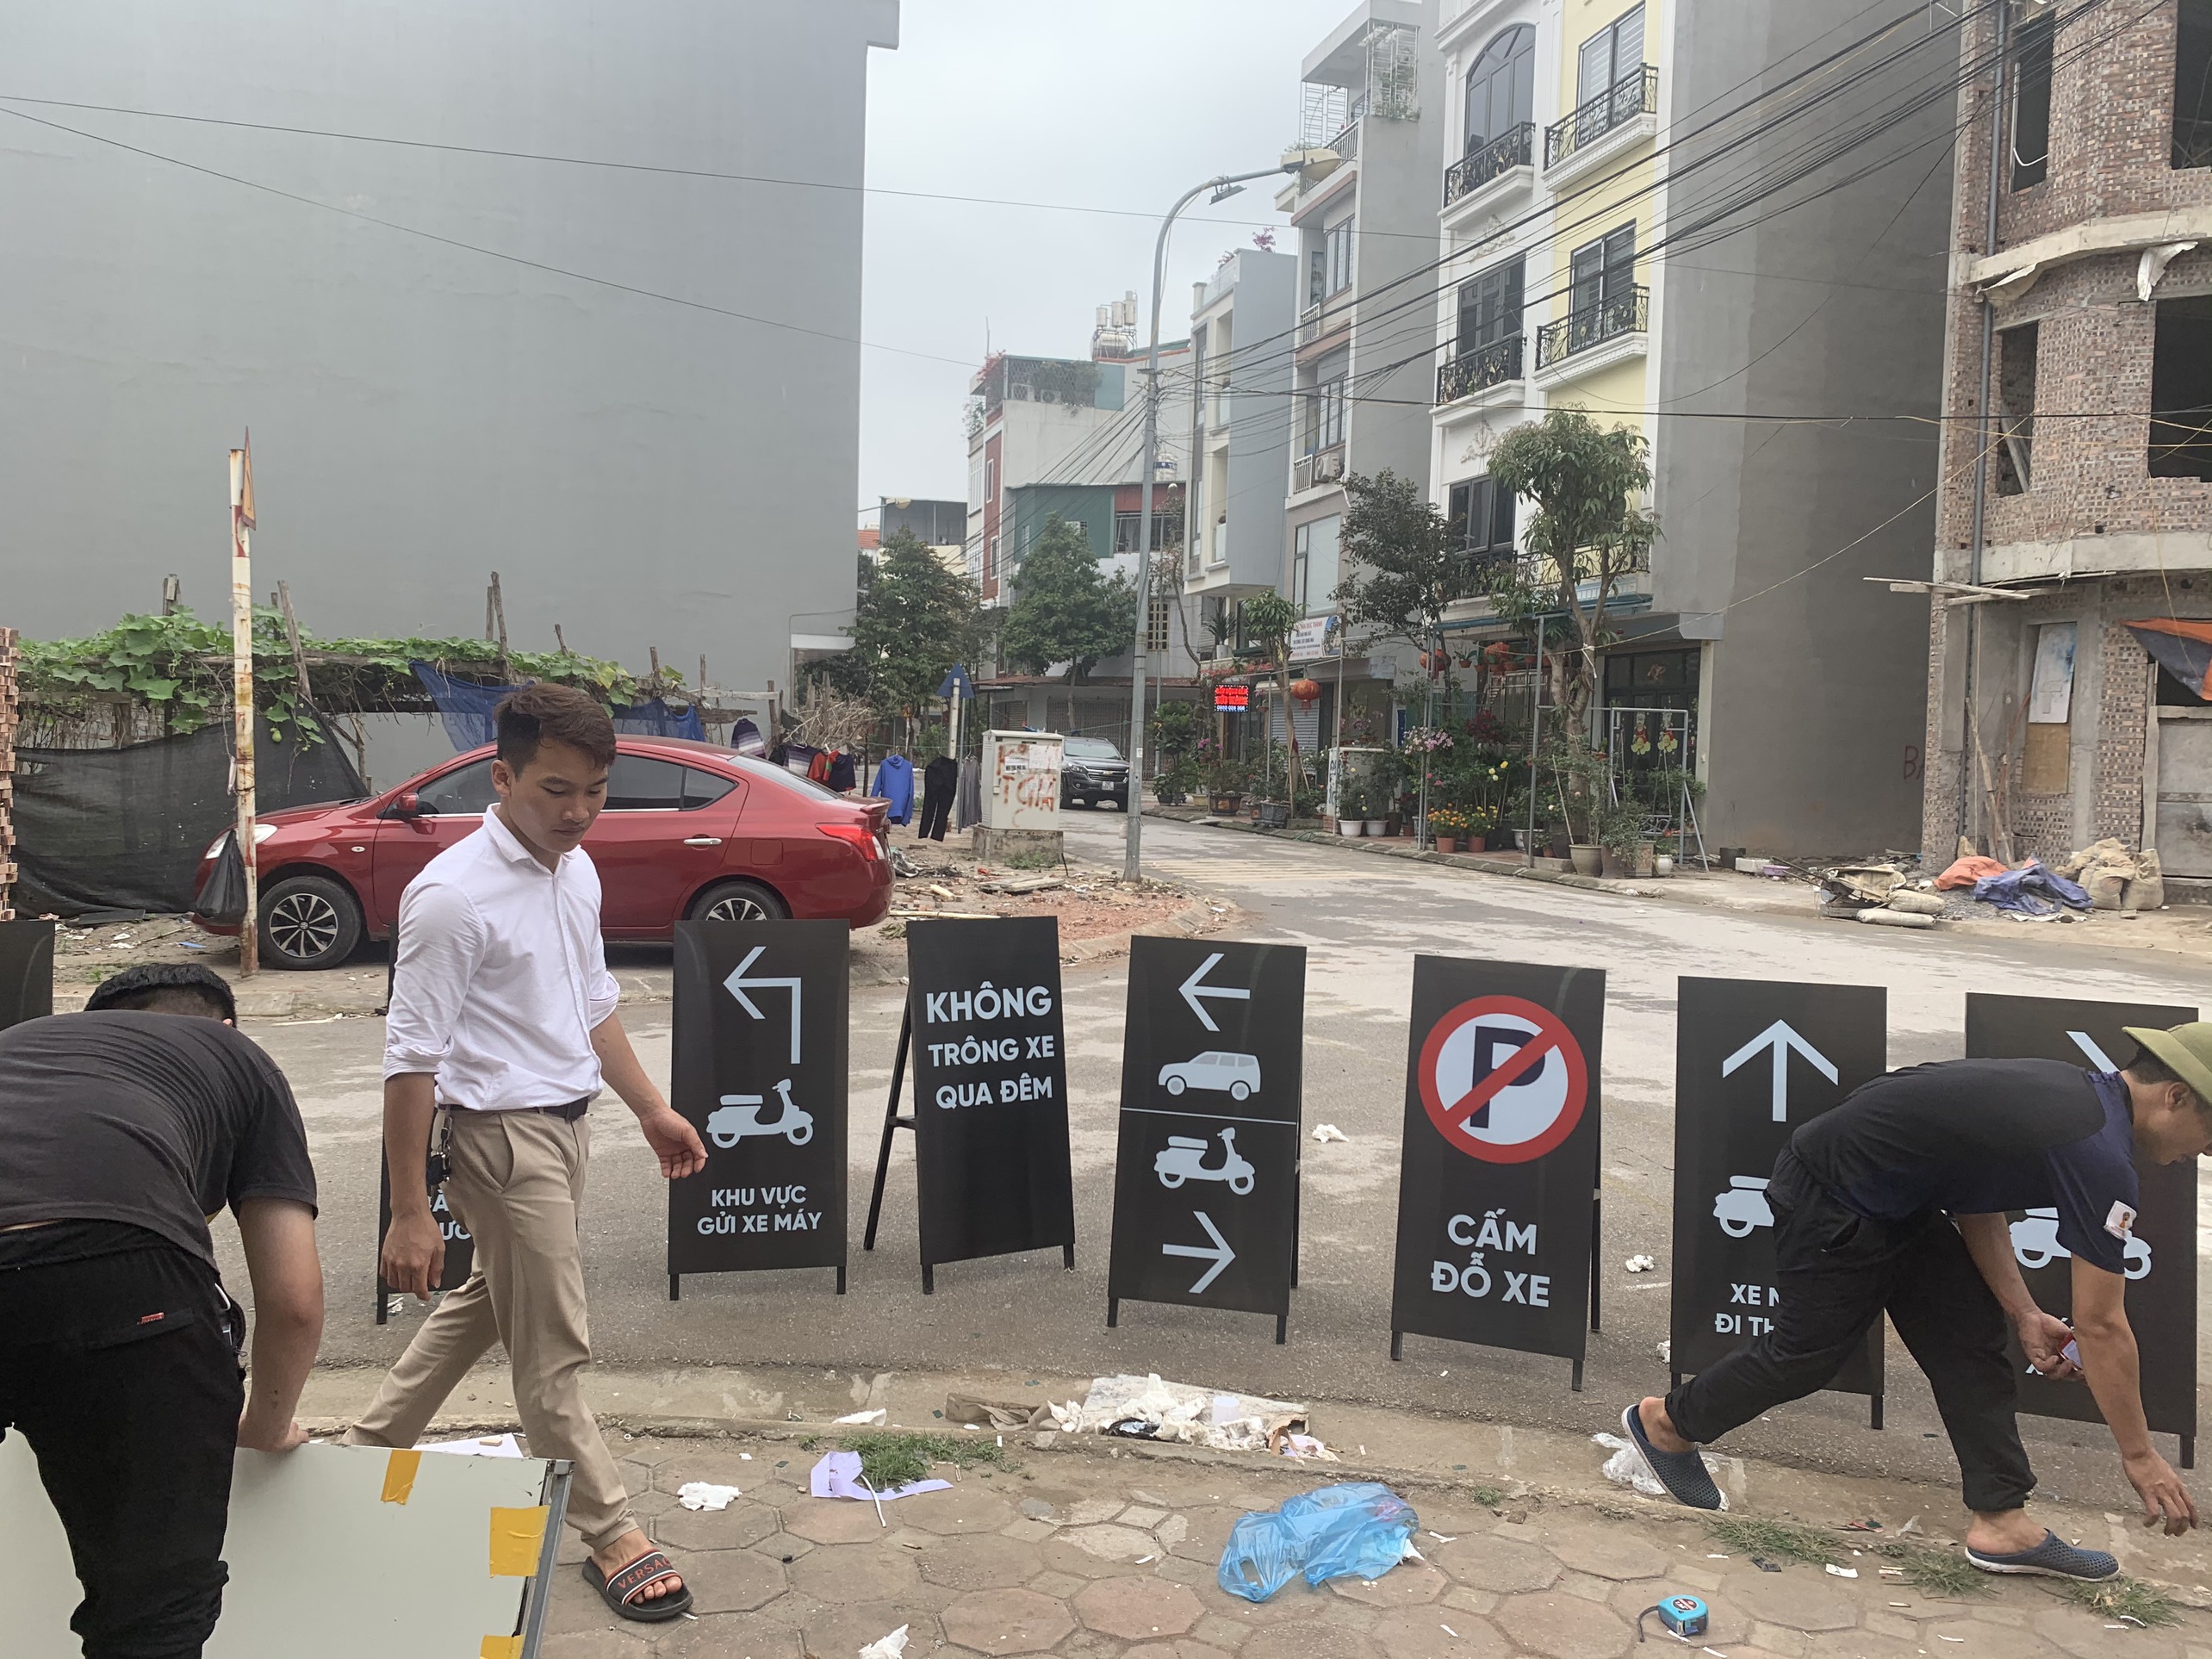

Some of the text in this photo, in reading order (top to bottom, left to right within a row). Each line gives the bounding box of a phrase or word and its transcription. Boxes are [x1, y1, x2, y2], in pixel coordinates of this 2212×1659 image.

[926, 980, 1052, 1023] KHÔNG
[928, 1035, 1055, 1067] TRÔNG XE
[935, 1072, 1053, 1109] QUA ĐÊM
[711, 1184, 807, 1209] KHU VỰC
[697, 1209, 823, 1235] GỬI XE MÁY
[1447, 1208, 1538, 1255] CẤM
[1431, 1252, 1550, 1308] ĐỖ XE
[1730, 1283, 1762, 1306] XE
[1714, 1313, 1774, 1336] ĐI TH
[617, 1556, 672, 1589] VERSAC
